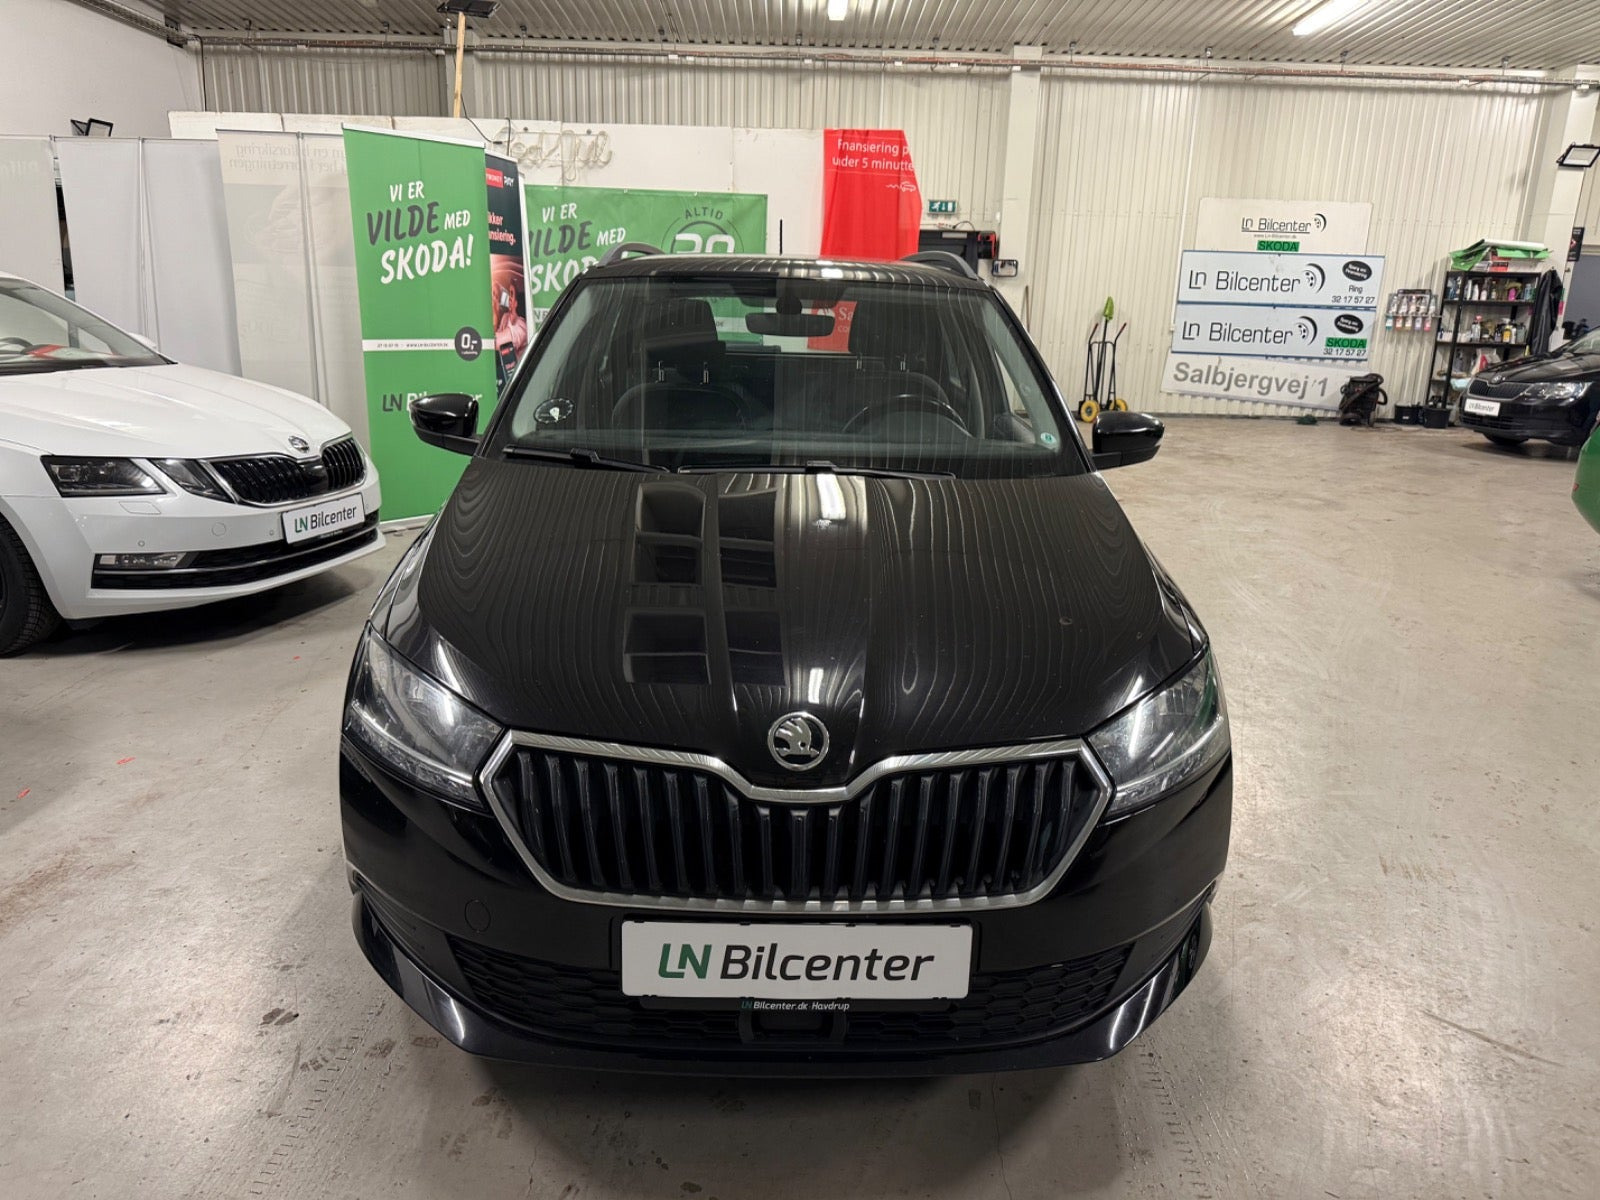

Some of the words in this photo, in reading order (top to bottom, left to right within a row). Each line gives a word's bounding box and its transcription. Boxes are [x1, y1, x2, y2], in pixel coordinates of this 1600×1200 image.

[862, 157, 869, 169] 5
[871, 158, 914, 172] minutte
[390, 183, 403, 202] VI
[408, 181, 425, 199] ER
[542, 207, 555, 223] VI
[560, 203, 577, 219] ER
[685, 207, 723, 220] ALTID
[367, 202, 439, 246] VILDE
[444, 209, 470, 230] MED
[1258, 217, 1312, 232] Bilcenter
[597, 228, 626, 247] MED
[1258, 240, 1298, 251] SKODA
[381, 234, 474, 284] SKODA!
[1216, 270, 1301, 292] Bilcenter
[1349, 285, 1363, 294] Ring
[1354, 296, 1363, 304] 57
[1209, 322, 1293, 345] Bilcenter
[1326, 337, 1367, 348] SKODA
[1173, 362, 1309, 400] Salbjergvej
[1318, 378, 1328, 397] 1
[382, 393, 402, 412] LN
[295, 516, 308, 533] LN
[311, 506, 357, 529] Bilcenter
[657, 943, 712, 980] LN
[720, 943, 935, 982] Bilcenter
[812, 1001, 850, 1012] Havdrup
